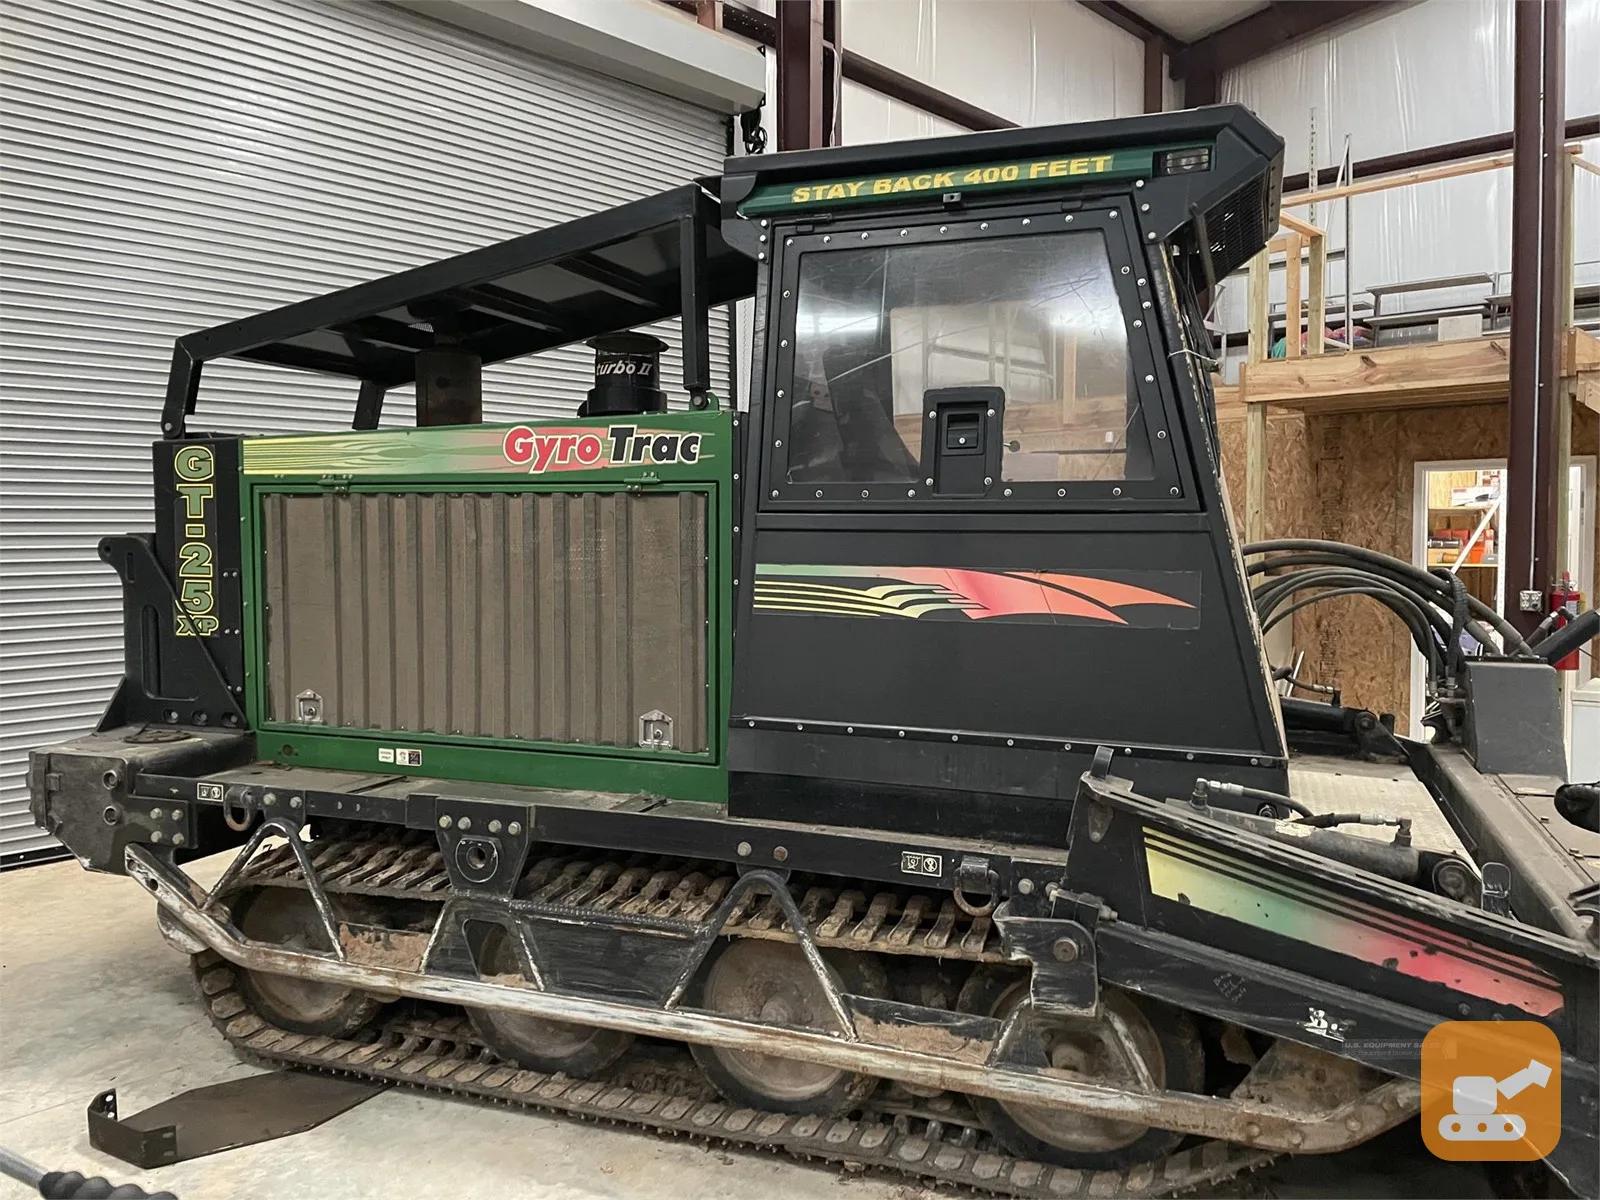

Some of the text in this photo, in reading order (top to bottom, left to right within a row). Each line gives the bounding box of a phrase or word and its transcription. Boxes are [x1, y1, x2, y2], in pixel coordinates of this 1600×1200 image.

[793, 156, 1112, 203] STAY BACK 400 FEET
[596, 360, 636, 376] turbo
[503, 424, 702, 474] Gyro Trac
[174, 445, 214, 615] GT-25
